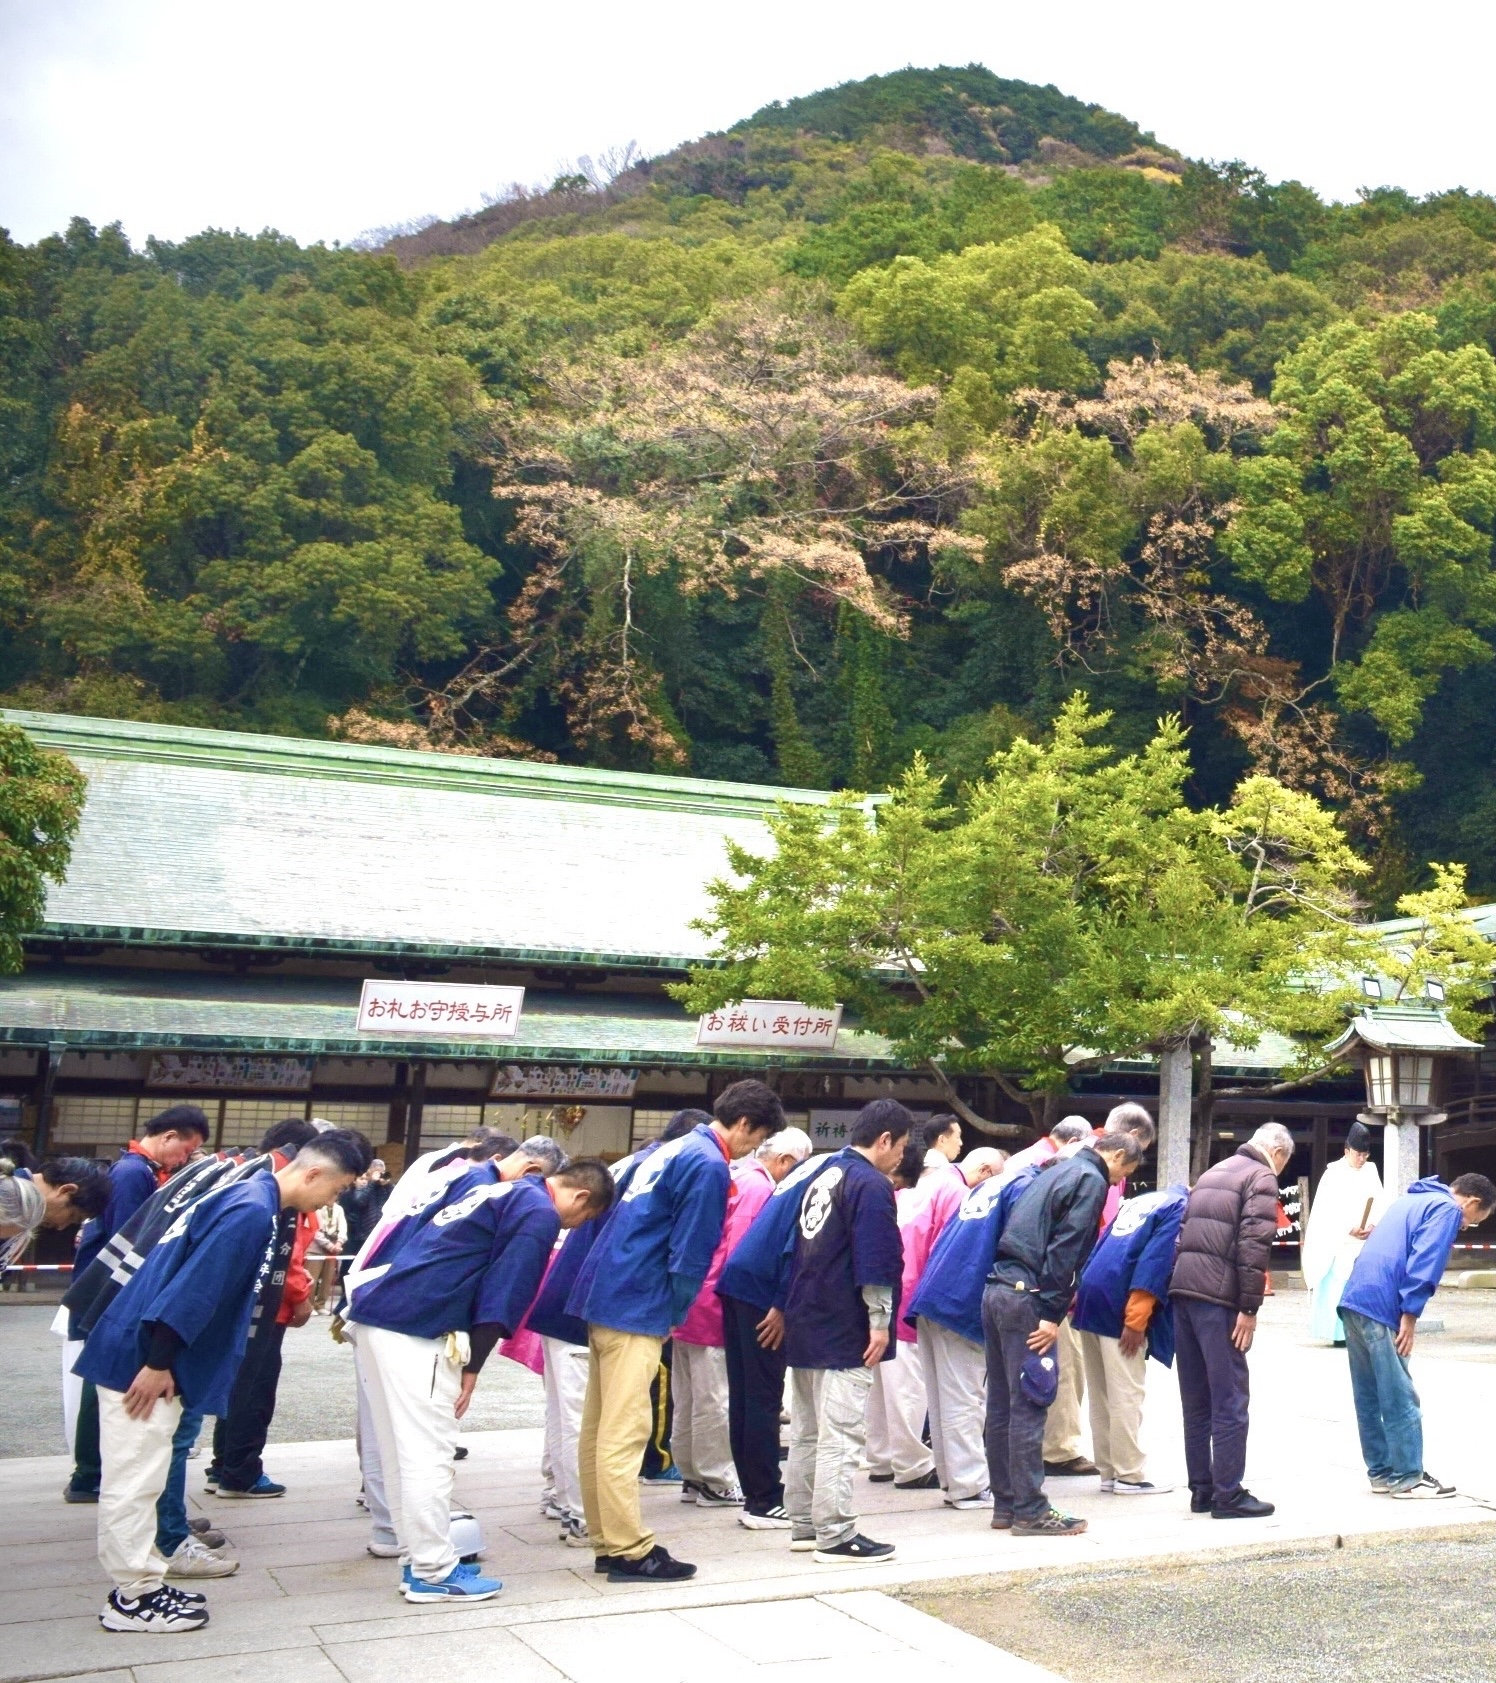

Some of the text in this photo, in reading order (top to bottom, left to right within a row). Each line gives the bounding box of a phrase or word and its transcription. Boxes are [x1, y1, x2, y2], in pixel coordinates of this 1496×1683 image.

[367, 998, 513, 1024] お札お守授与所
[707, 1013, 834, 1037] お祓い受付所
